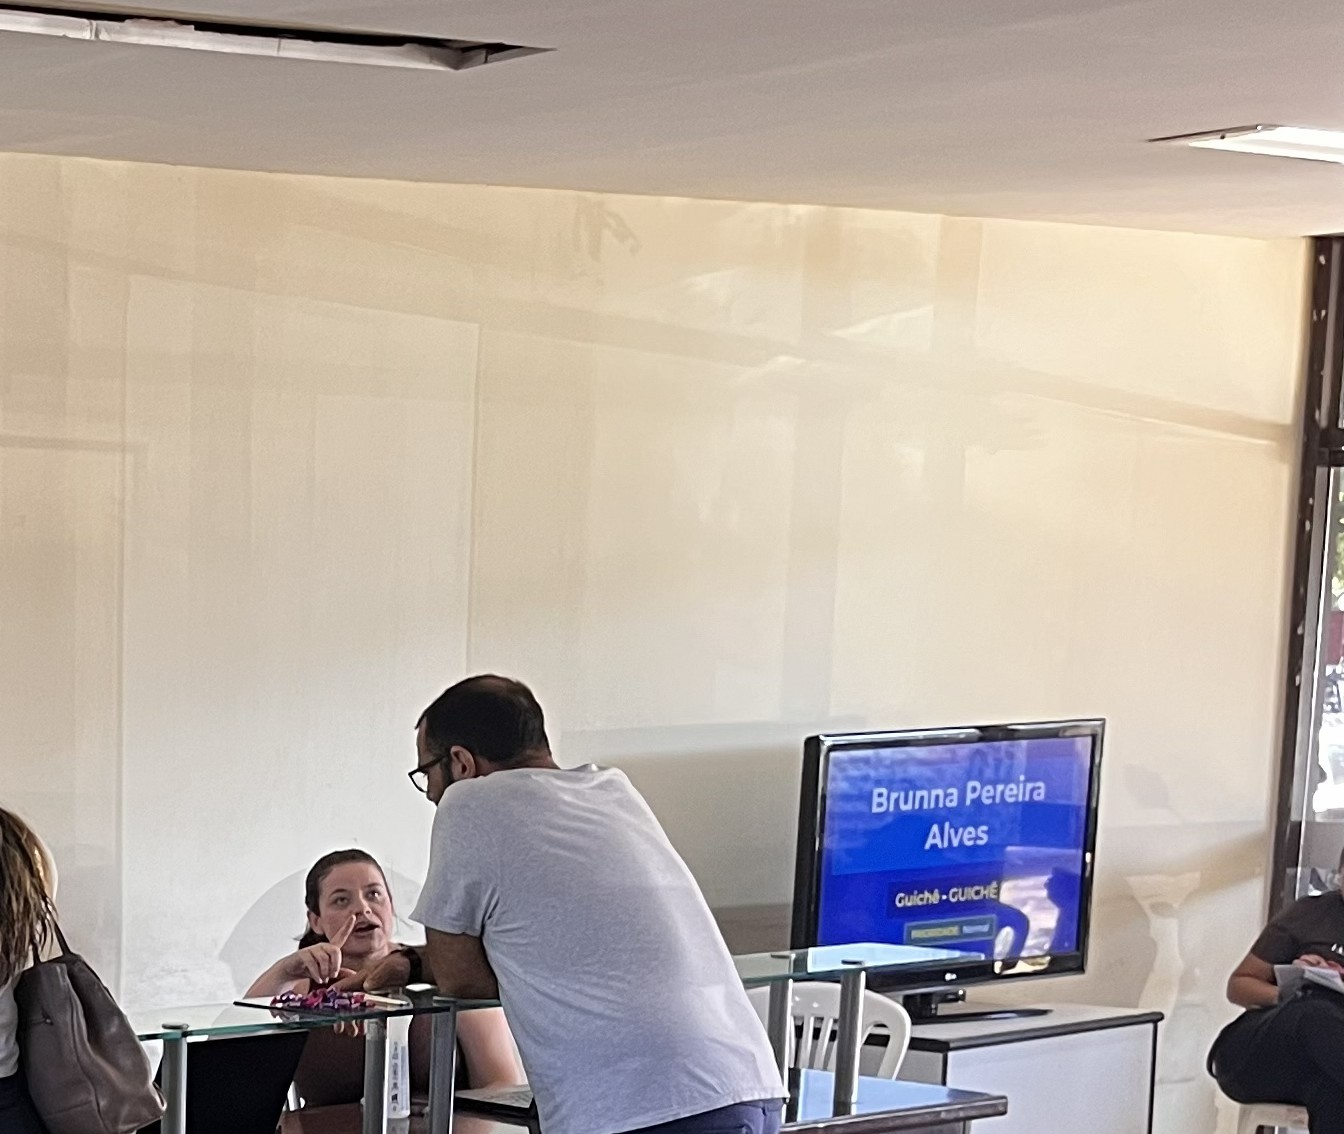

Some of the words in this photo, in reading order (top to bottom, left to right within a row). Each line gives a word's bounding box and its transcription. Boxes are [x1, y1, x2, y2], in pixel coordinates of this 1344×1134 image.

[872, 787, 958, 814] Brunna
[966, 774, 1046, 806] Pereira
[924, 821, 989, 850] Alves
[895, 889, 940, 908] Guichê
